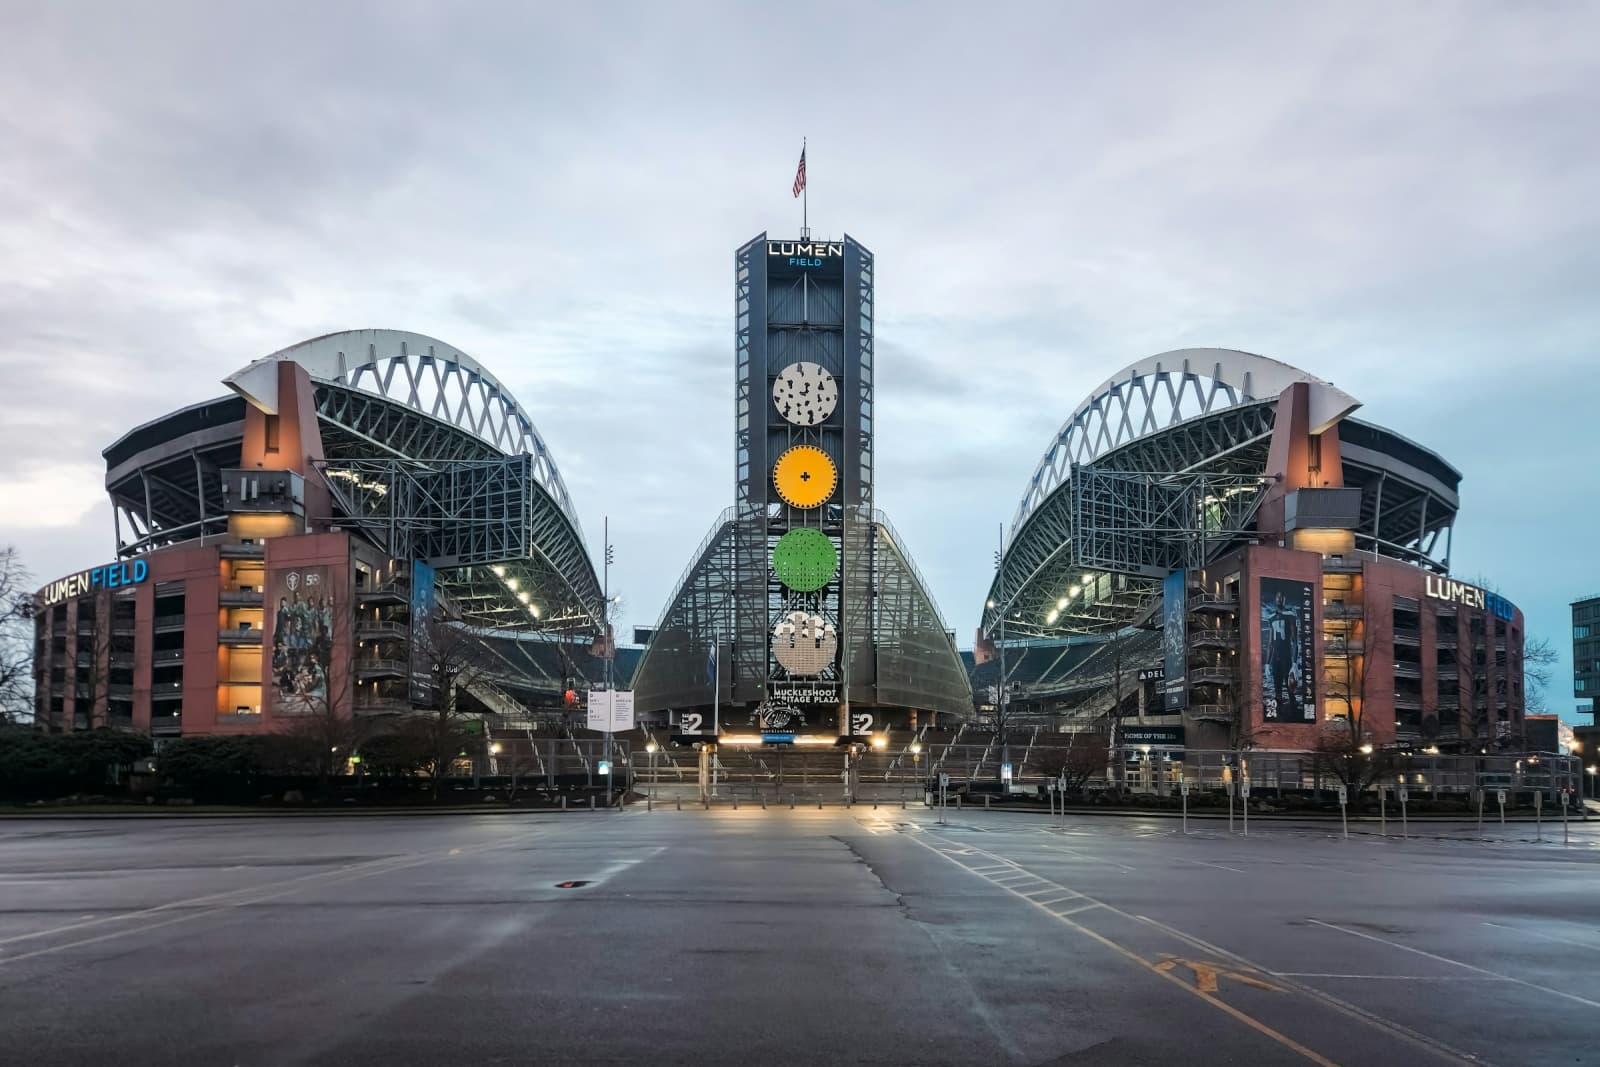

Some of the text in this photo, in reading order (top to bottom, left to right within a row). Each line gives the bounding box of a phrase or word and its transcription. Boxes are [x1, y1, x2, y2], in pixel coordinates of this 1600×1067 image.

[768, 243, 842, 257] LUMEN
[789, 258, 822, 266] FIELD
[44, 559, 148, 605] LUMEN FIELD
[1425, 575, 1485, 610] LUMEN
[1147, 670, 1165, 679] DEL
[774, 689, 836, 697] MUCKLESHOOT
[688, 713, 703, 735] 2
[852, 713, 873, 736] GATE 2
